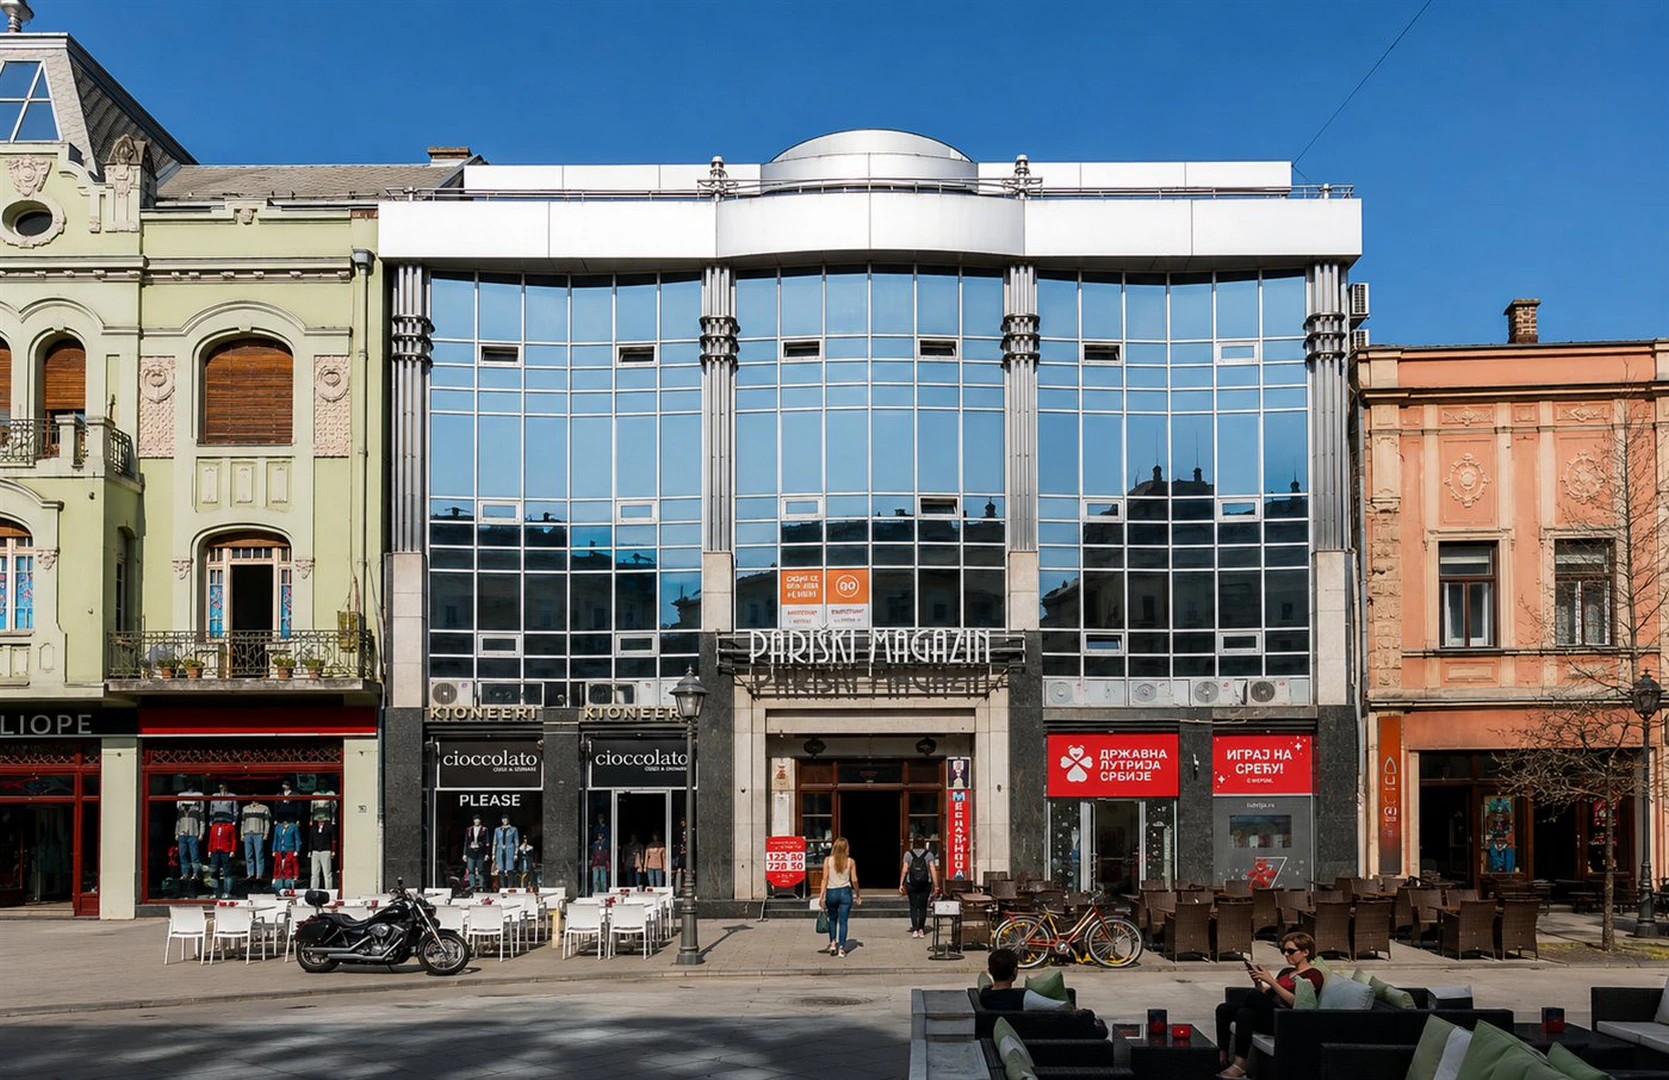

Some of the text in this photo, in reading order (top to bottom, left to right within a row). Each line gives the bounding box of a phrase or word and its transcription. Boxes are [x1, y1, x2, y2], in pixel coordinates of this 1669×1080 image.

[749, 624, 990, 664] PARIŠKI MAGAZIN
[0, 714, 92, 735] LIOPE
[443, 749, 538, 766] cioccolato
[595, 748, 689, 765] cioccolato
[1100, 749, 1168, 760] ДРЖАВНА
[1226, 749, 1292, 760] ИГРАЈ НА
[1100, 760, 1161, 770] ЛУТРИЈА
[1235, 763, 1284, 774] СРЕЋУ!
[1100, 771, 1152, 781] СРБИЈЕ
[459, 794, 521, 807] PLEASE
